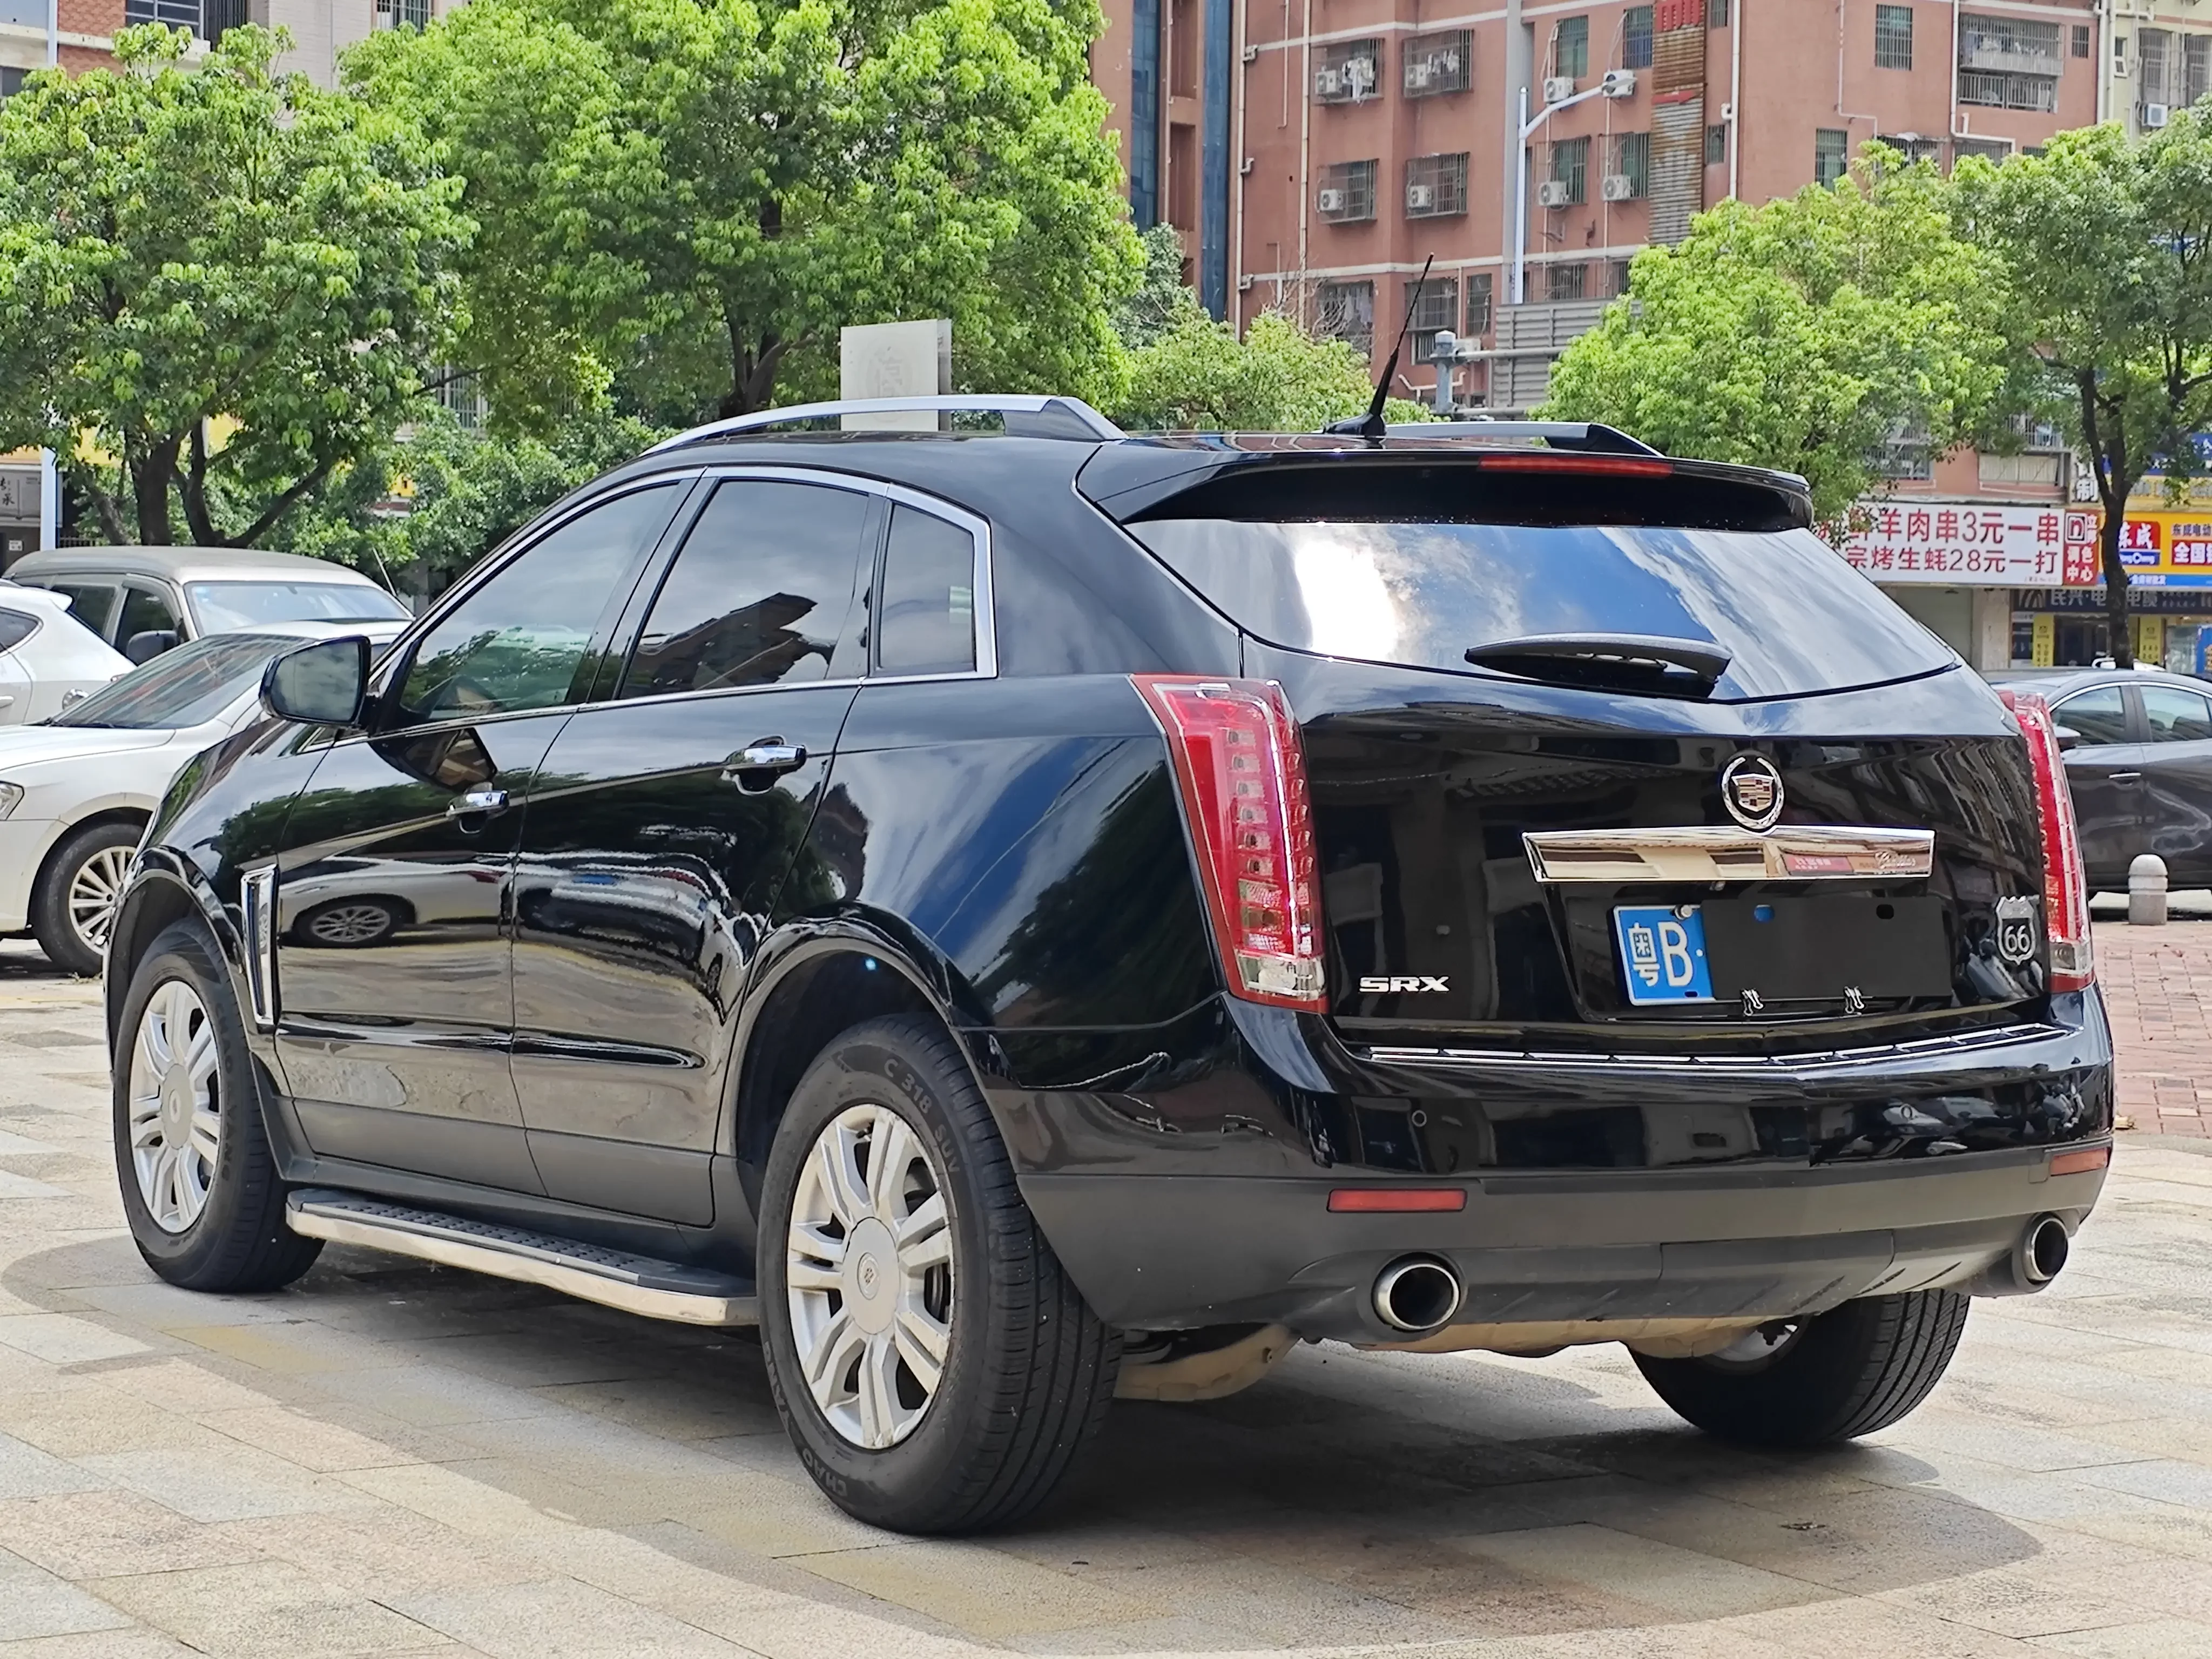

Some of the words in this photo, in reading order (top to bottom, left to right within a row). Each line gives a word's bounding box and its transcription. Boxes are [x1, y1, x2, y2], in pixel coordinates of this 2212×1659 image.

[1819, 509, 2059, 546] 羊肉串3元一串
[1845, 544, 2058, 574] 宗烤生蚝28元一打
[2004, 925, 2031, 953] 66
[1359, 976, 1450, 993] SRX
[901, 1073, 933, 1114] 318
[934, 1123, 960, 1172] SUV
